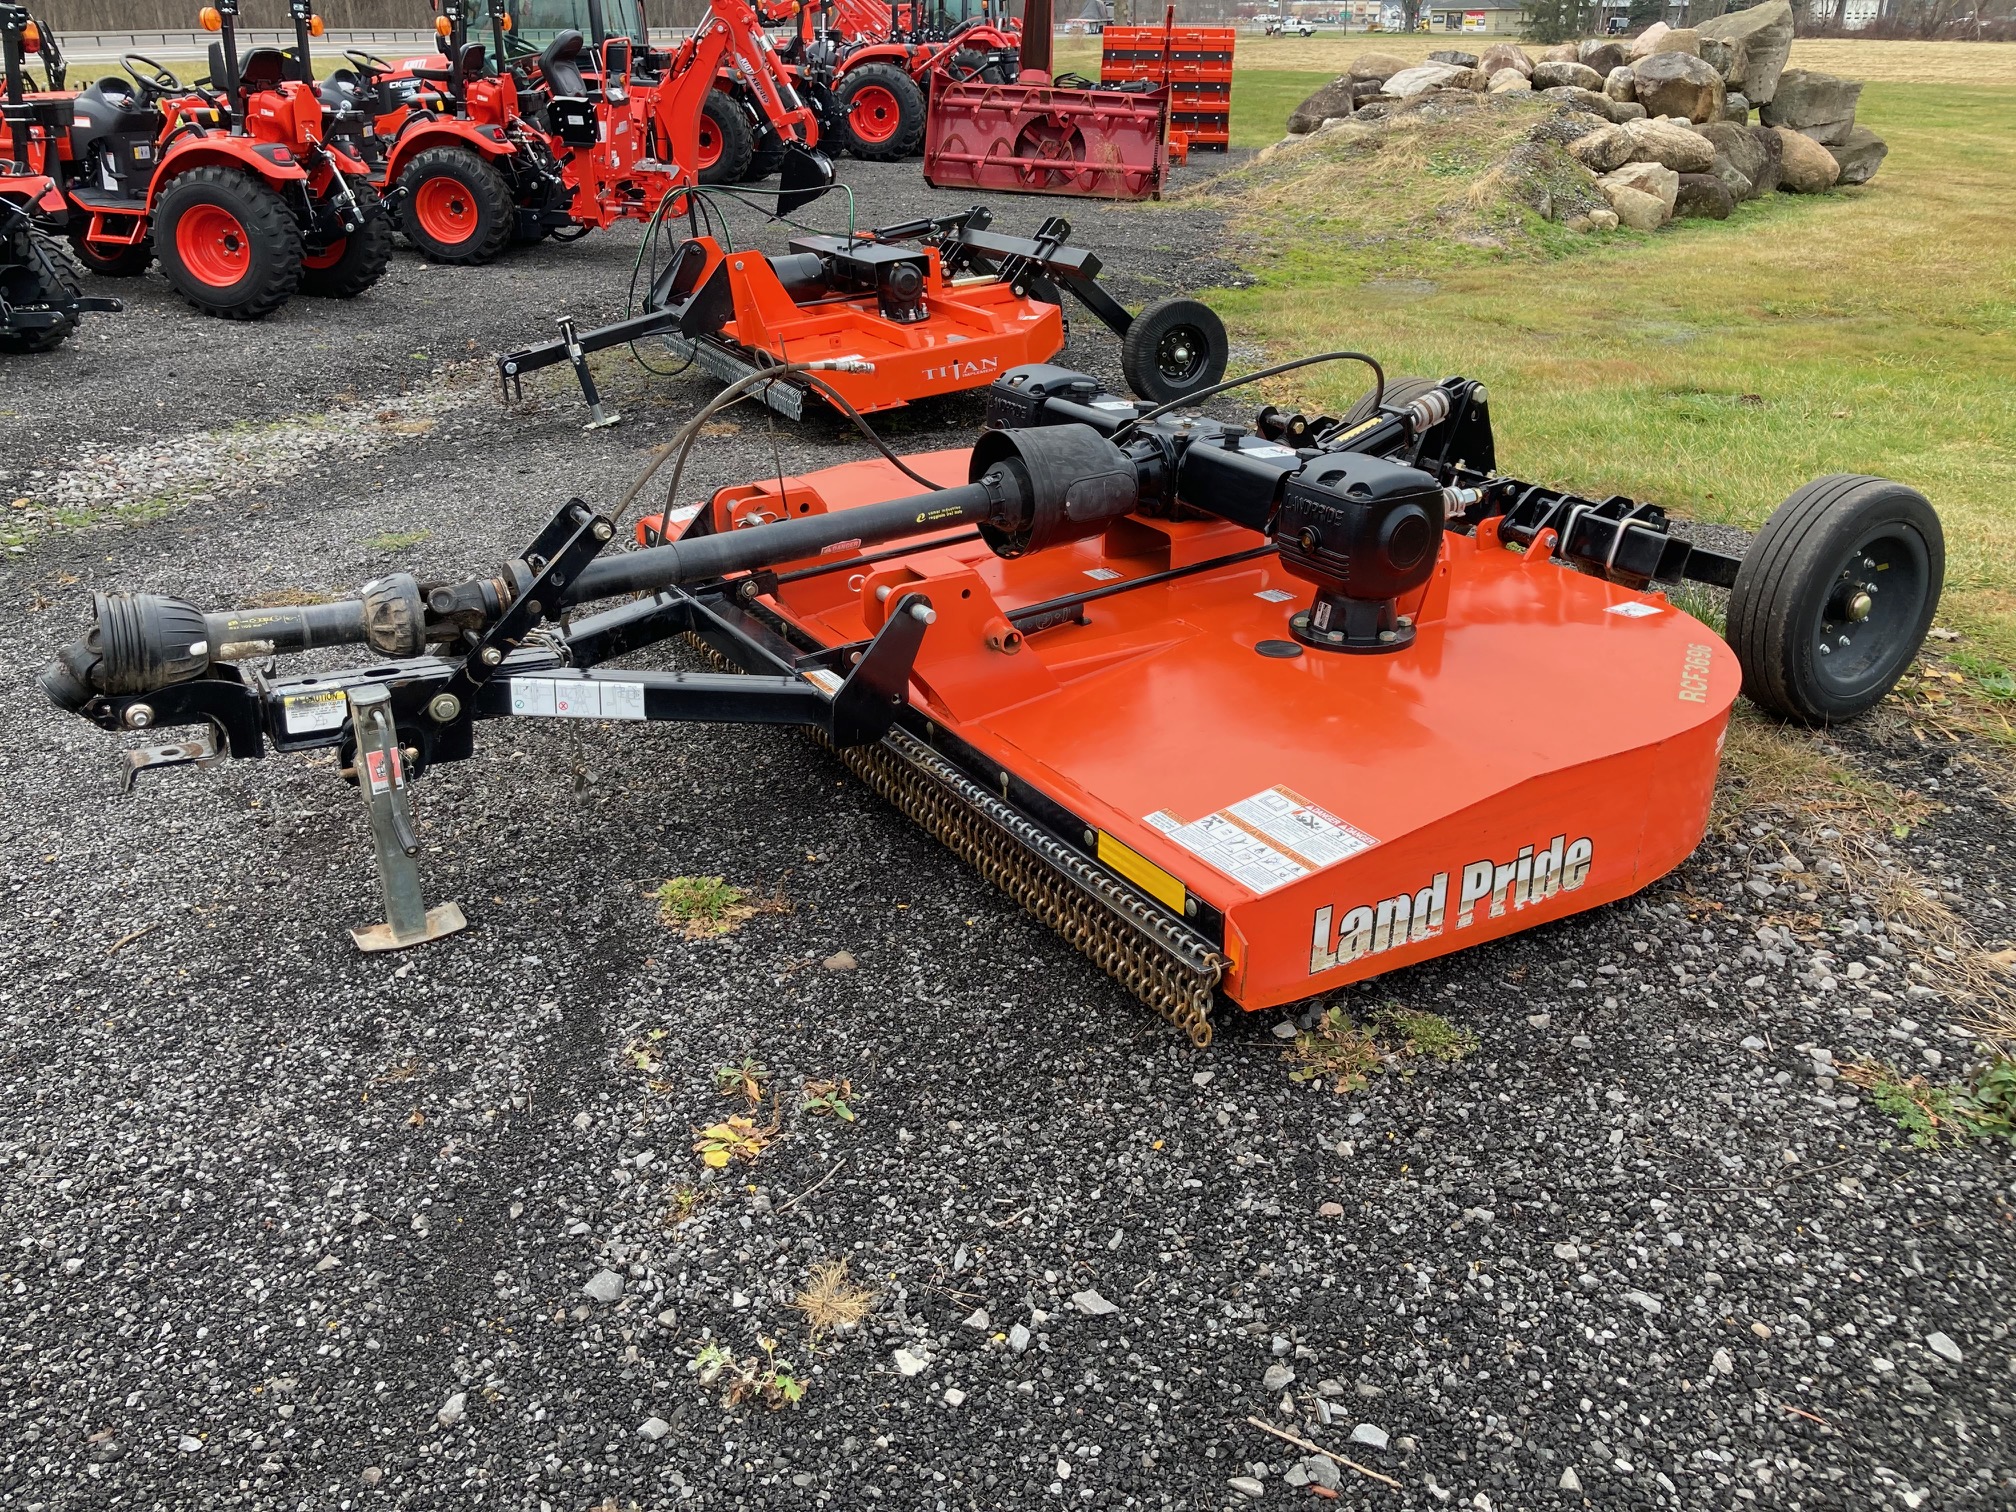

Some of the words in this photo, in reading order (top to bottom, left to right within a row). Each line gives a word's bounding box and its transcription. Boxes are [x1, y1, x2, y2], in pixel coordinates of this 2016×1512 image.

[921, 357, 998, 381] TITAN
[832, 541, 859, 551] DANGER
[1678, 643, 1713, 703] RCF3696
[305, 693, 338, 704] CAUTION
[1312, 807, 1340, 826] DANGER
[1345, 827, 1376, 845] DANGER
[1309, 872, 1449, 975] Land
[1456, 833, 1593, 930] Pride
